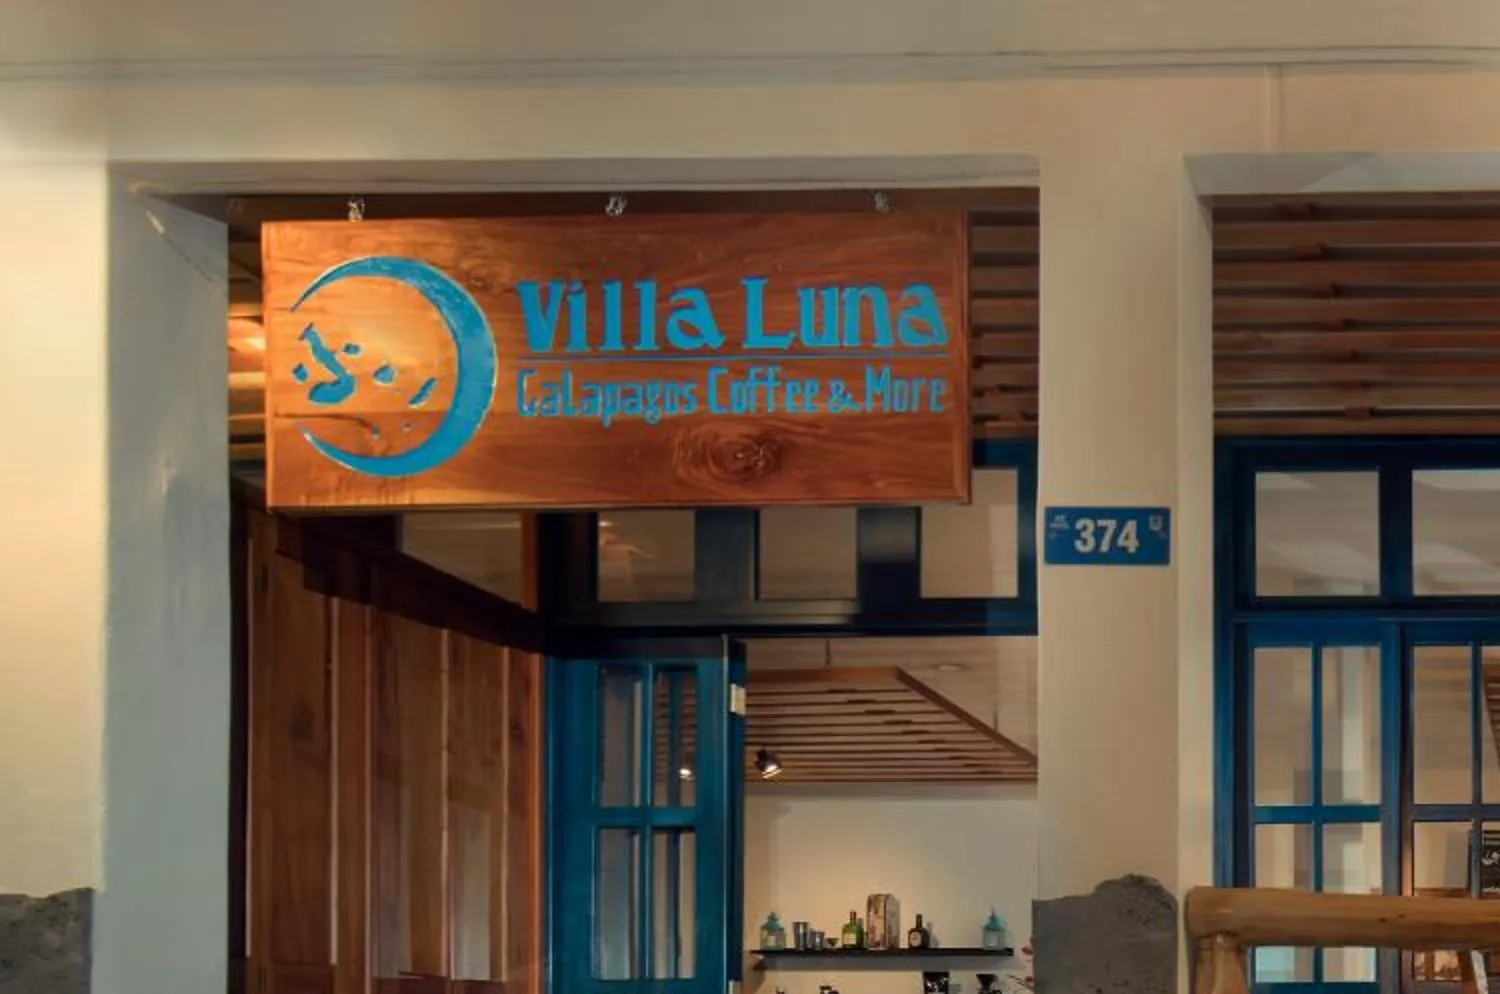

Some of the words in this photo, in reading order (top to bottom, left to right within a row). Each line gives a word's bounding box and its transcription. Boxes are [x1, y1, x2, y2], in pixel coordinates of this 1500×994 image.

[516, 278, 727, 353] Villa
[740, 276, 950, 350] Luna
[706, 364, 821, 415] Coffee
[828, 378, 861, 413] &
[865, 364, 949, 413] More
[1074, 517, 1139, 553] 374
